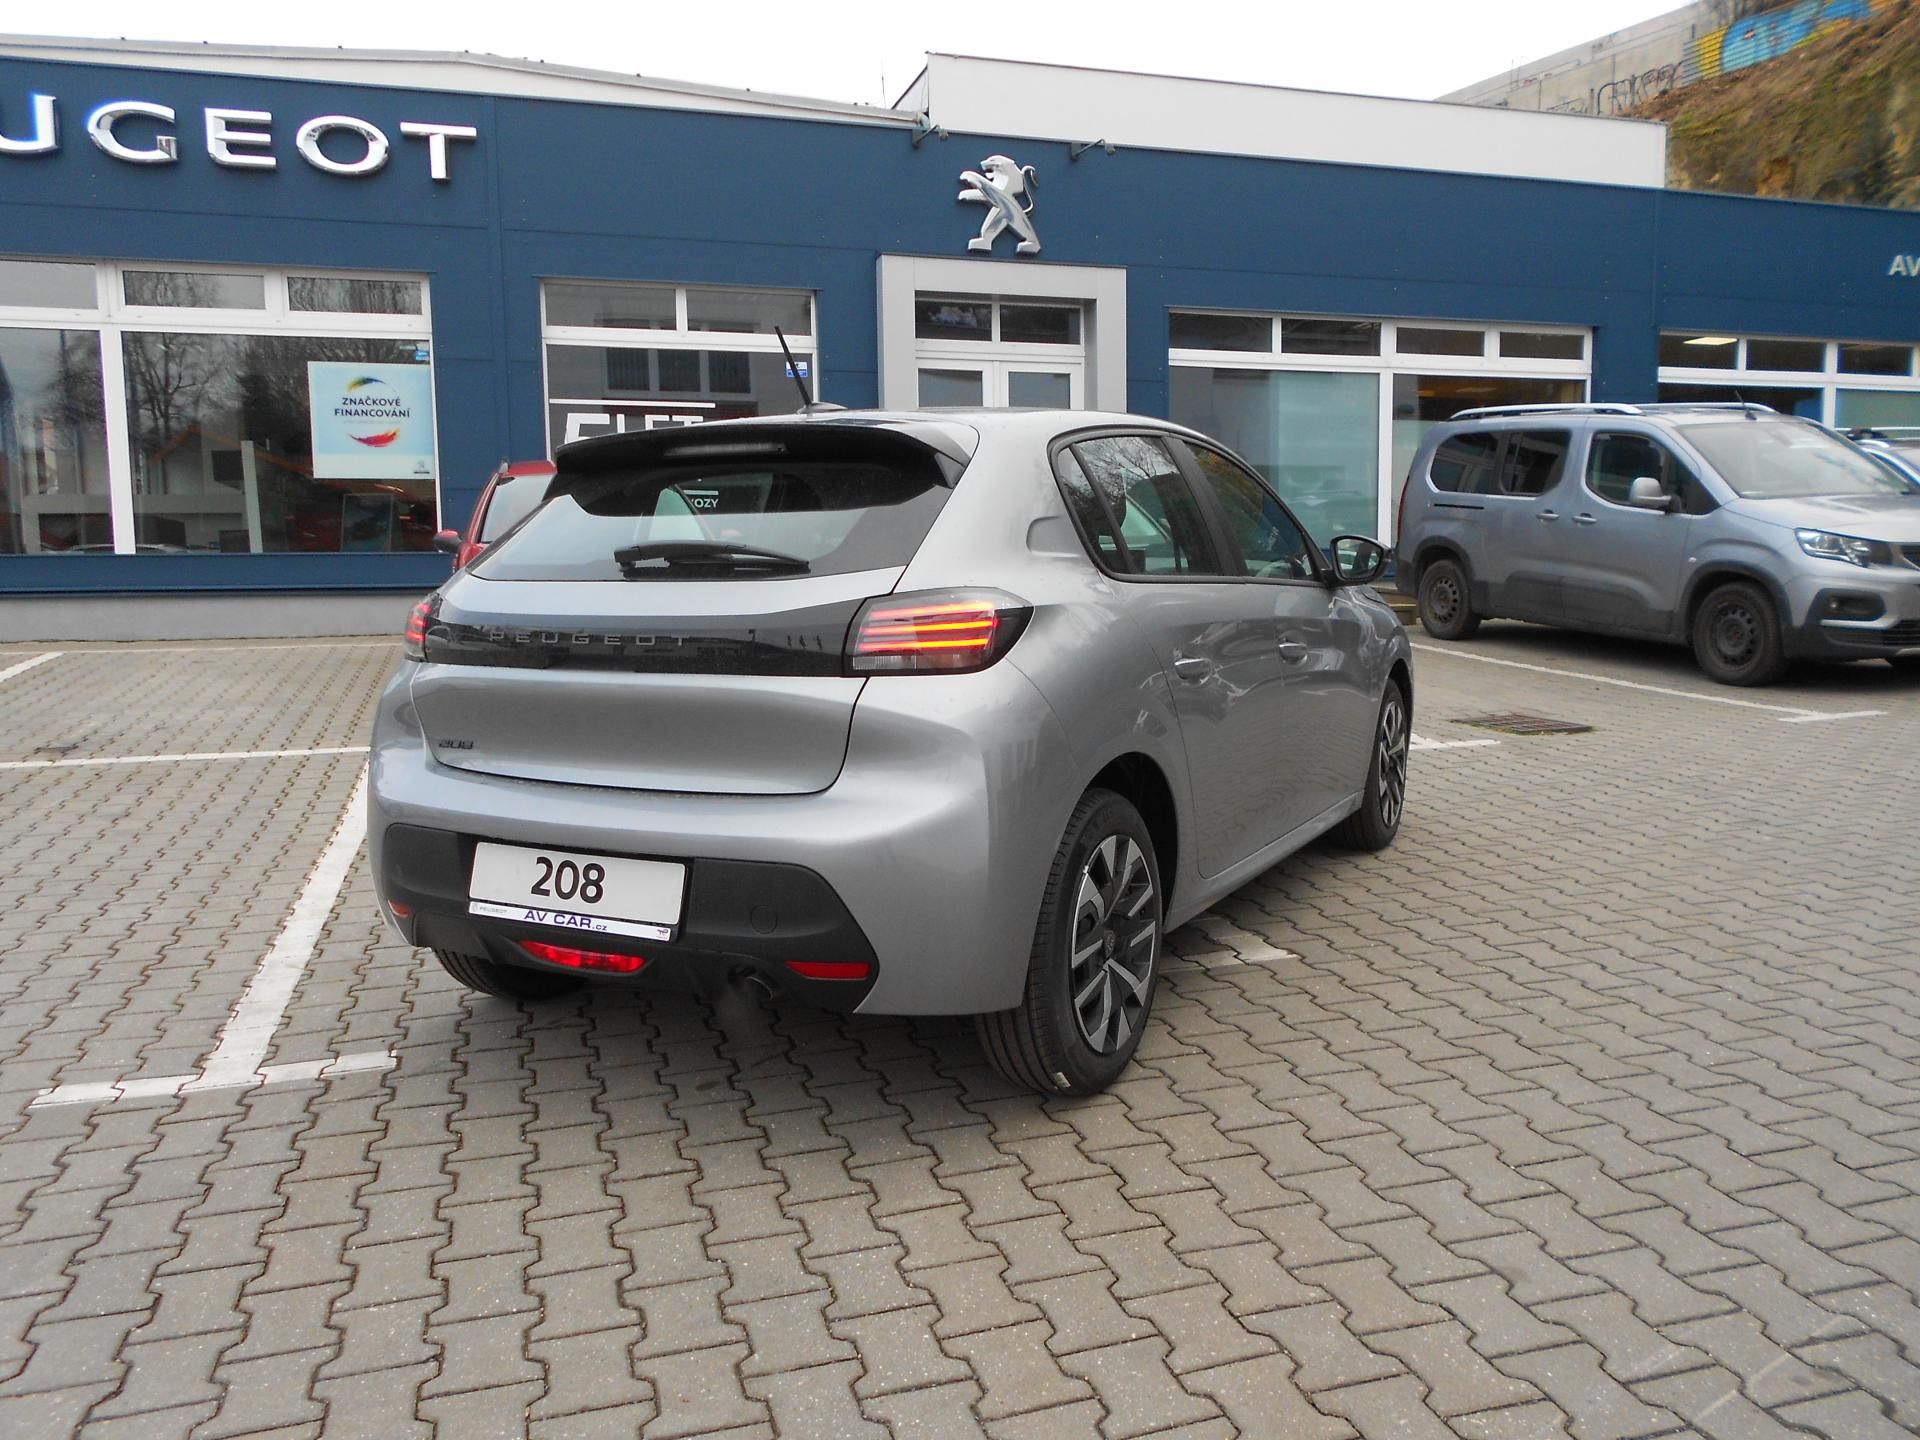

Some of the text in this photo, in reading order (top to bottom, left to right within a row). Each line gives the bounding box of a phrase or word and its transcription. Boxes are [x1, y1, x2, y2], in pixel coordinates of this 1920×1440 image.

[0, 93, 478, 182] UGEOT
[341, 395, 401, 407] ZNAČKOVÉ
[334, 407, 410, 418] FINANCOVÁNÍ
[691, 498, 719, 508] OZY
[489, 631, 691, 647] PEUGEOT
[438, 738, 475, 750] 208
[530, 856, 606, 904] 208
[524, 910, 548, 923] AV
